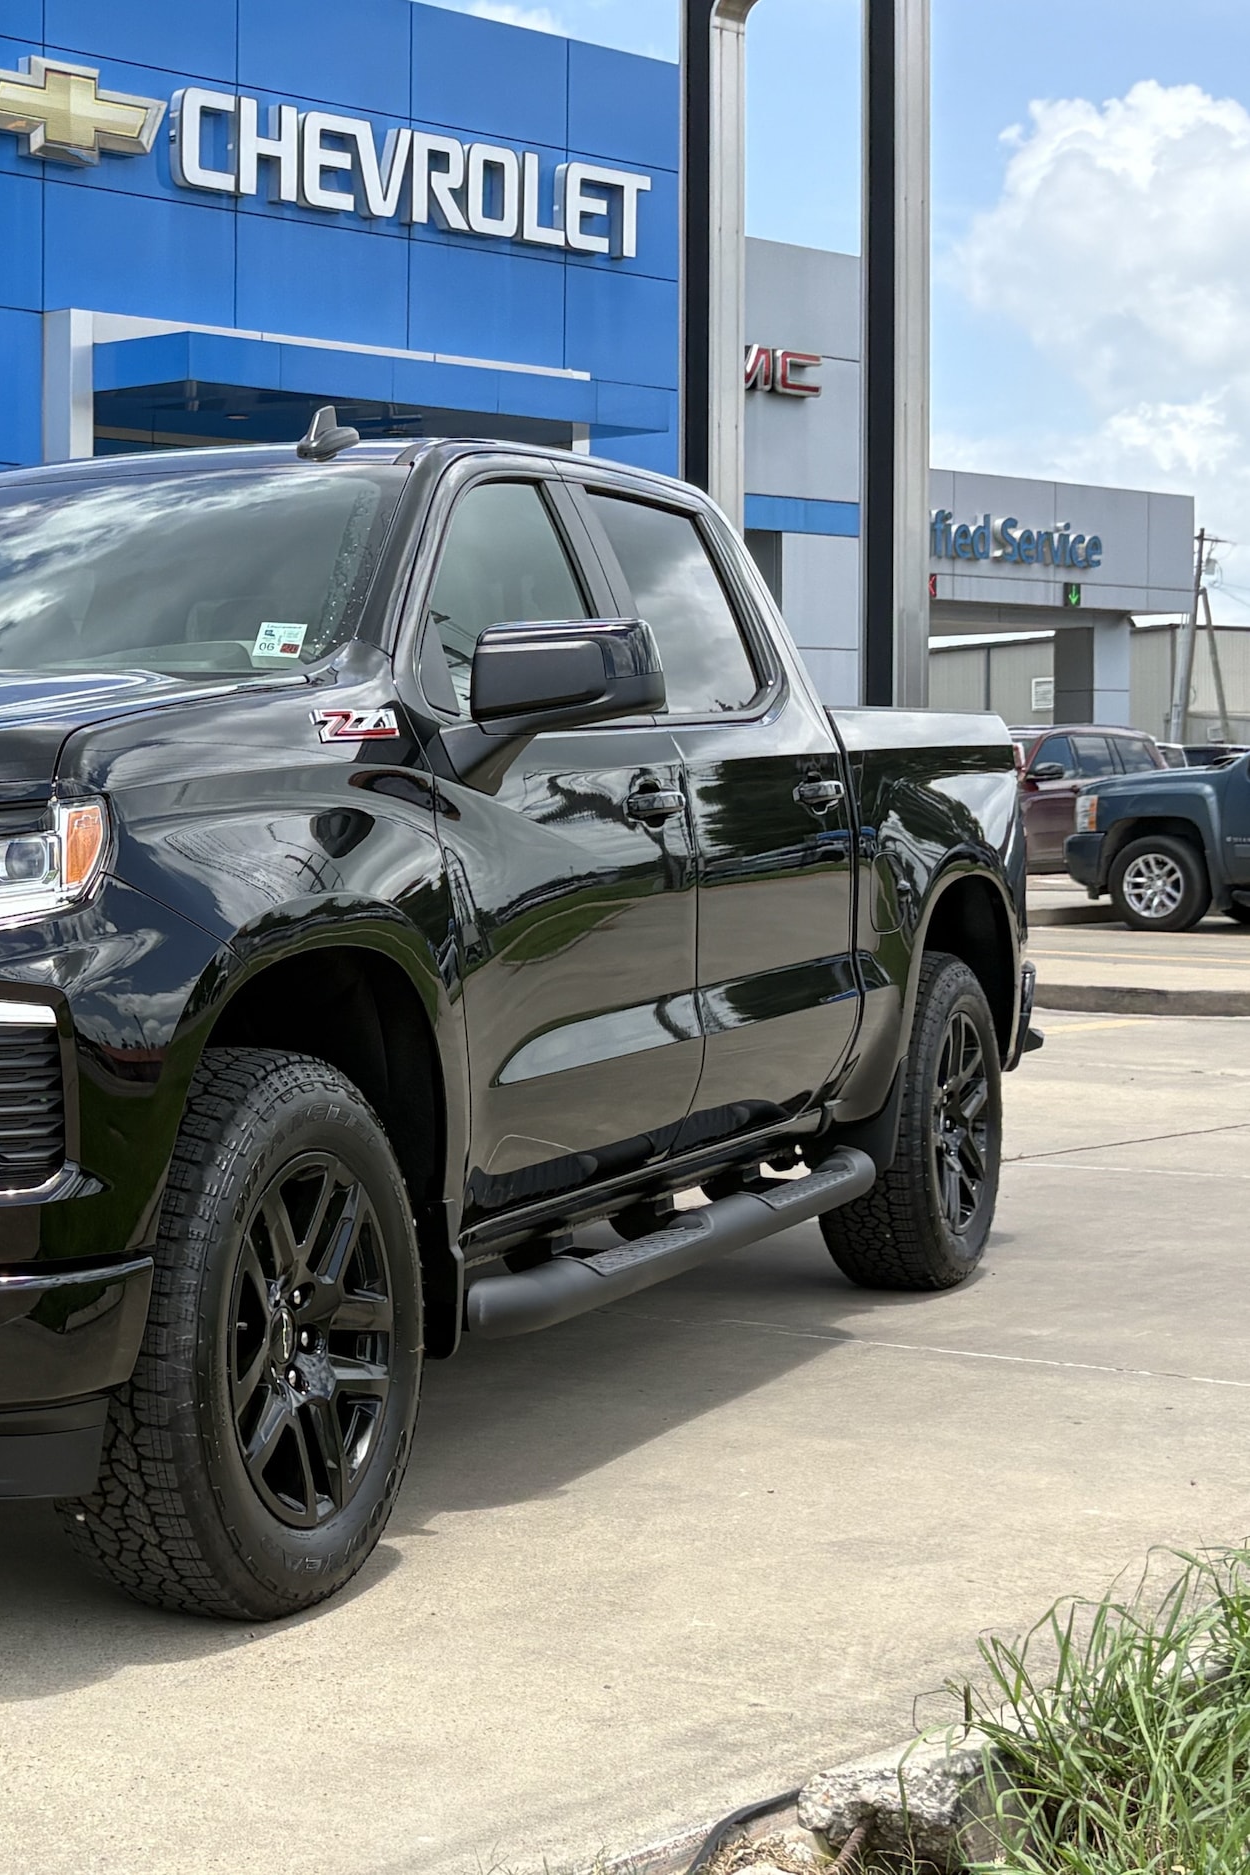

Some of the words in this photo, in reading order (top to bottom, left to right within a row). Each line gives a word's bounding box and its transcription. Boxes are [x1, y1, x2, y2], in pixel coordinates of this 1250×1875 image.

[169, 86, 651, 259] CHEVROLET
[744, 343, 823, 399] MC
[929, 509, 991, 560] fied
[996, 516, 1103, 569] Service
[308, 708, 400, 743] Z71
